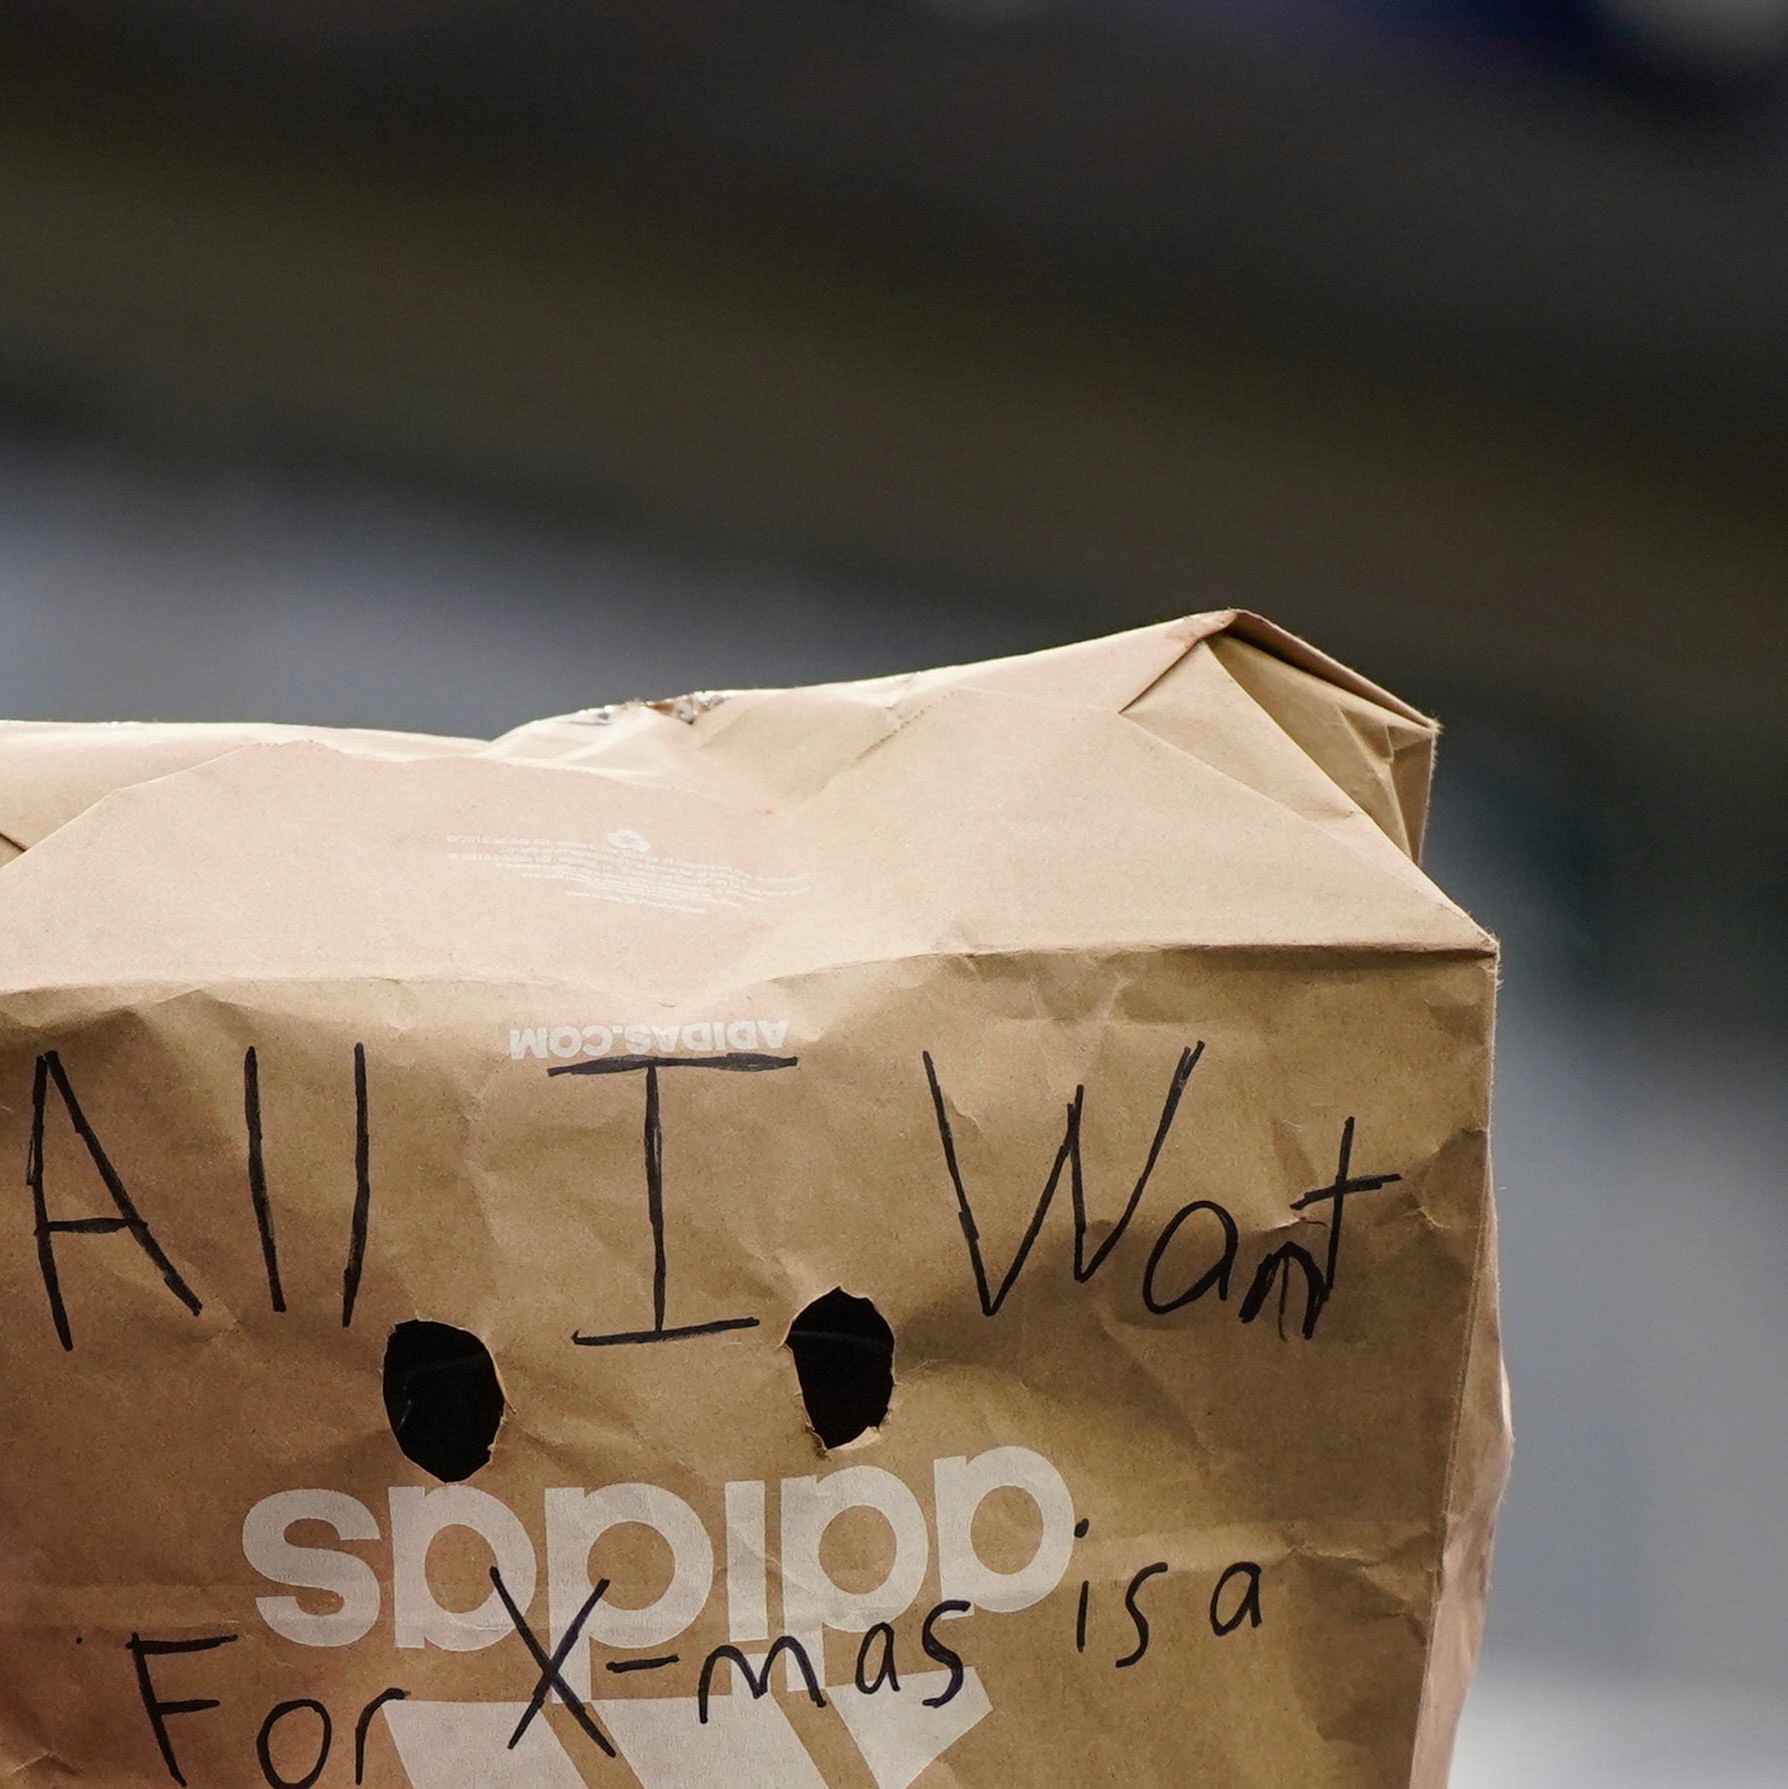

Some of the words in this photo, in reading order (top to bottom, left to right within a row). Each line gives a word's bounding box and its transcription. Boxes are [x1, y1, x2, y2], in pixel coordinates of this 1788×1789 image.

[509, 1020, 791, 1060] ADIDAS.COM
[25, 1045, 372, 1352] All
[546, 1052, 800, 1348] I
[920, 1040, 1403, 1342] Want
[240, 1444, 1078, 1706] adidas
[487, 1565, 972, 1758] X-mas
[1073, 1517, 1172, 1670] is
[1208, 1560, 1266, 1638] a
